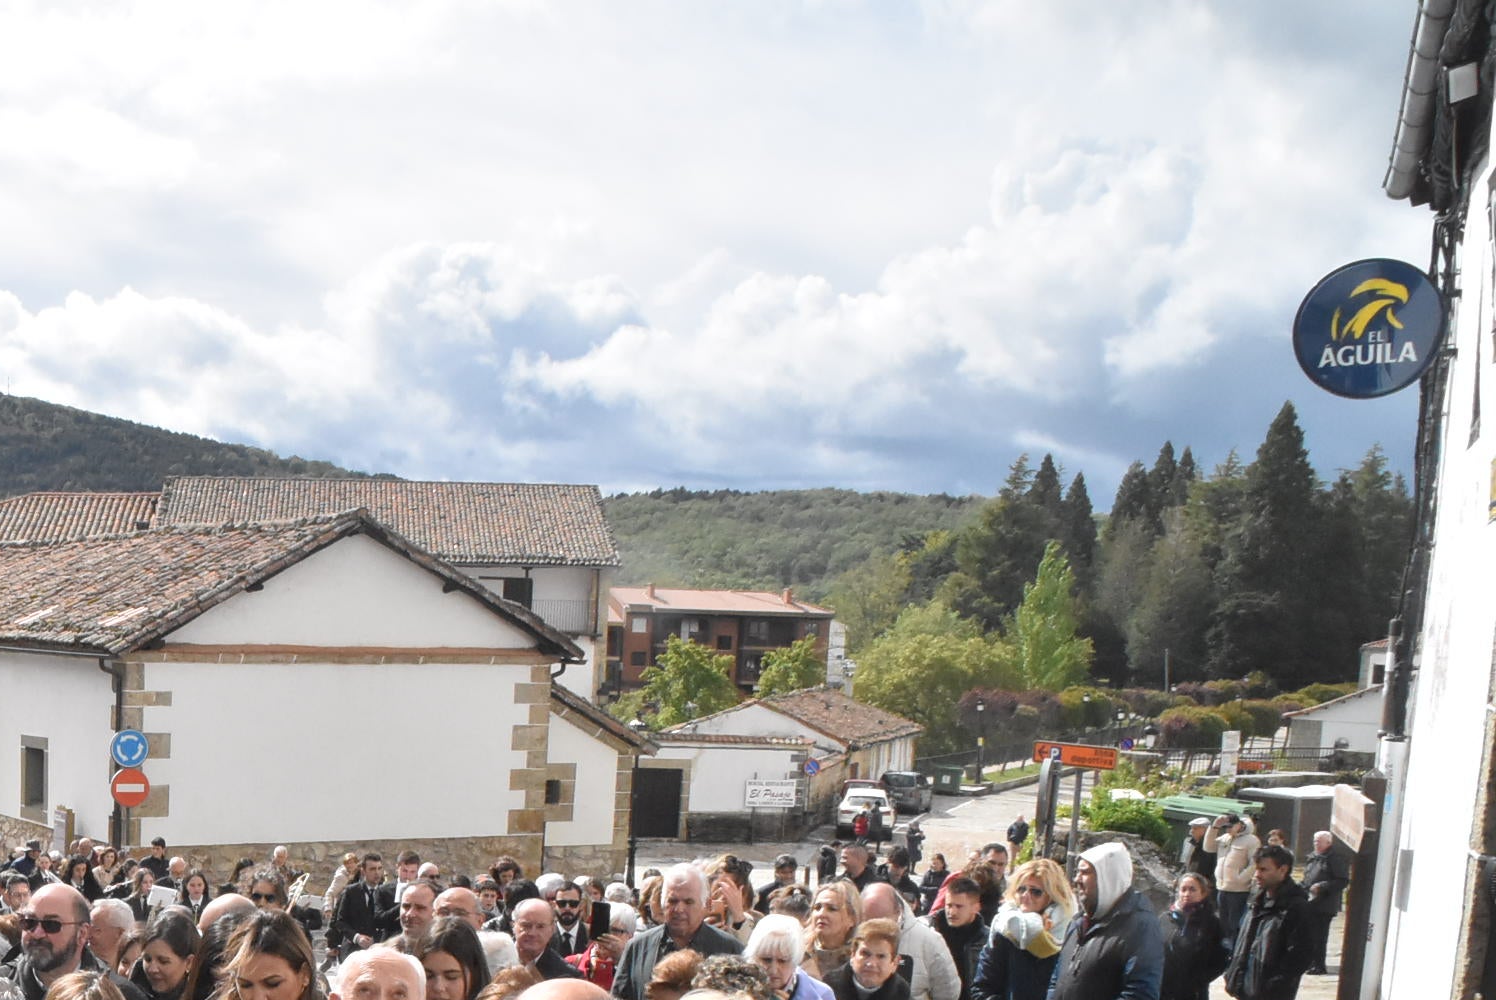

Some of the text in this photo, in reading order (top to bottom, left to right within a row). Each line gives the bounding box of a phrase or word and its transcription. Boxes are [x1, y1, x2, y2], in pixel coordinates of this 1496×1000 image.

[1368, 331, 1384, 343] EL
[1317, 341, 1418, 368] ÁGUILA
[749, 788, 761, 798] El
